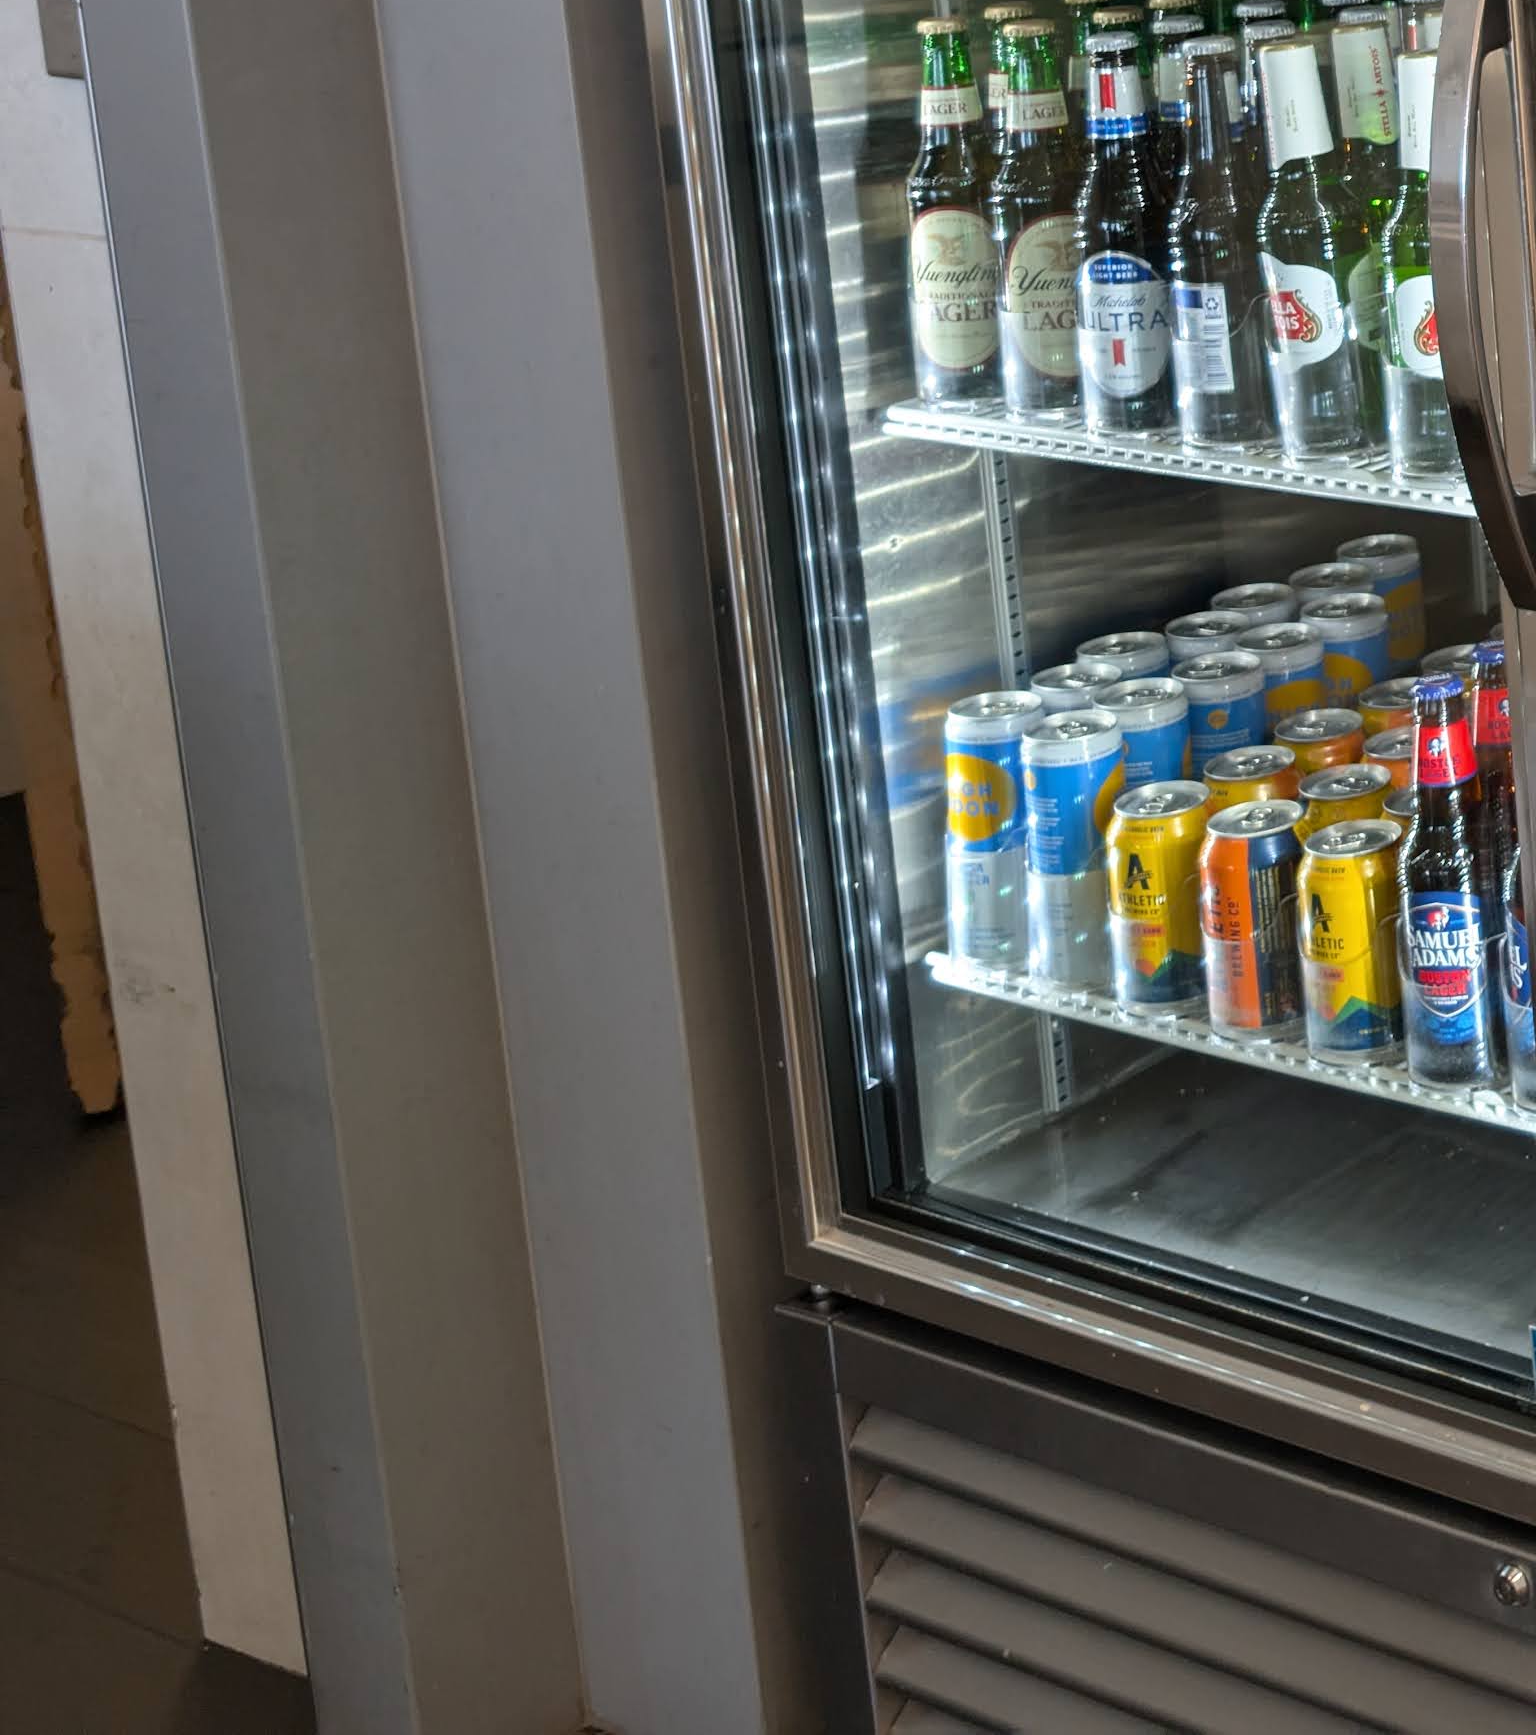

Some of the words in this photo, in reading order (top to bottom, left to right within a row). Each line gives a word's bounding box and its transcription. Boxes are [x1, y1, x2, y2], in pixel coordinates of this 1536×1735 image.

[1085, 310, 1169, 332] ULTRA
[1407, 923, 1481, 950] SAMUEL
[1412, 946, 1482, 967] ADAMS
